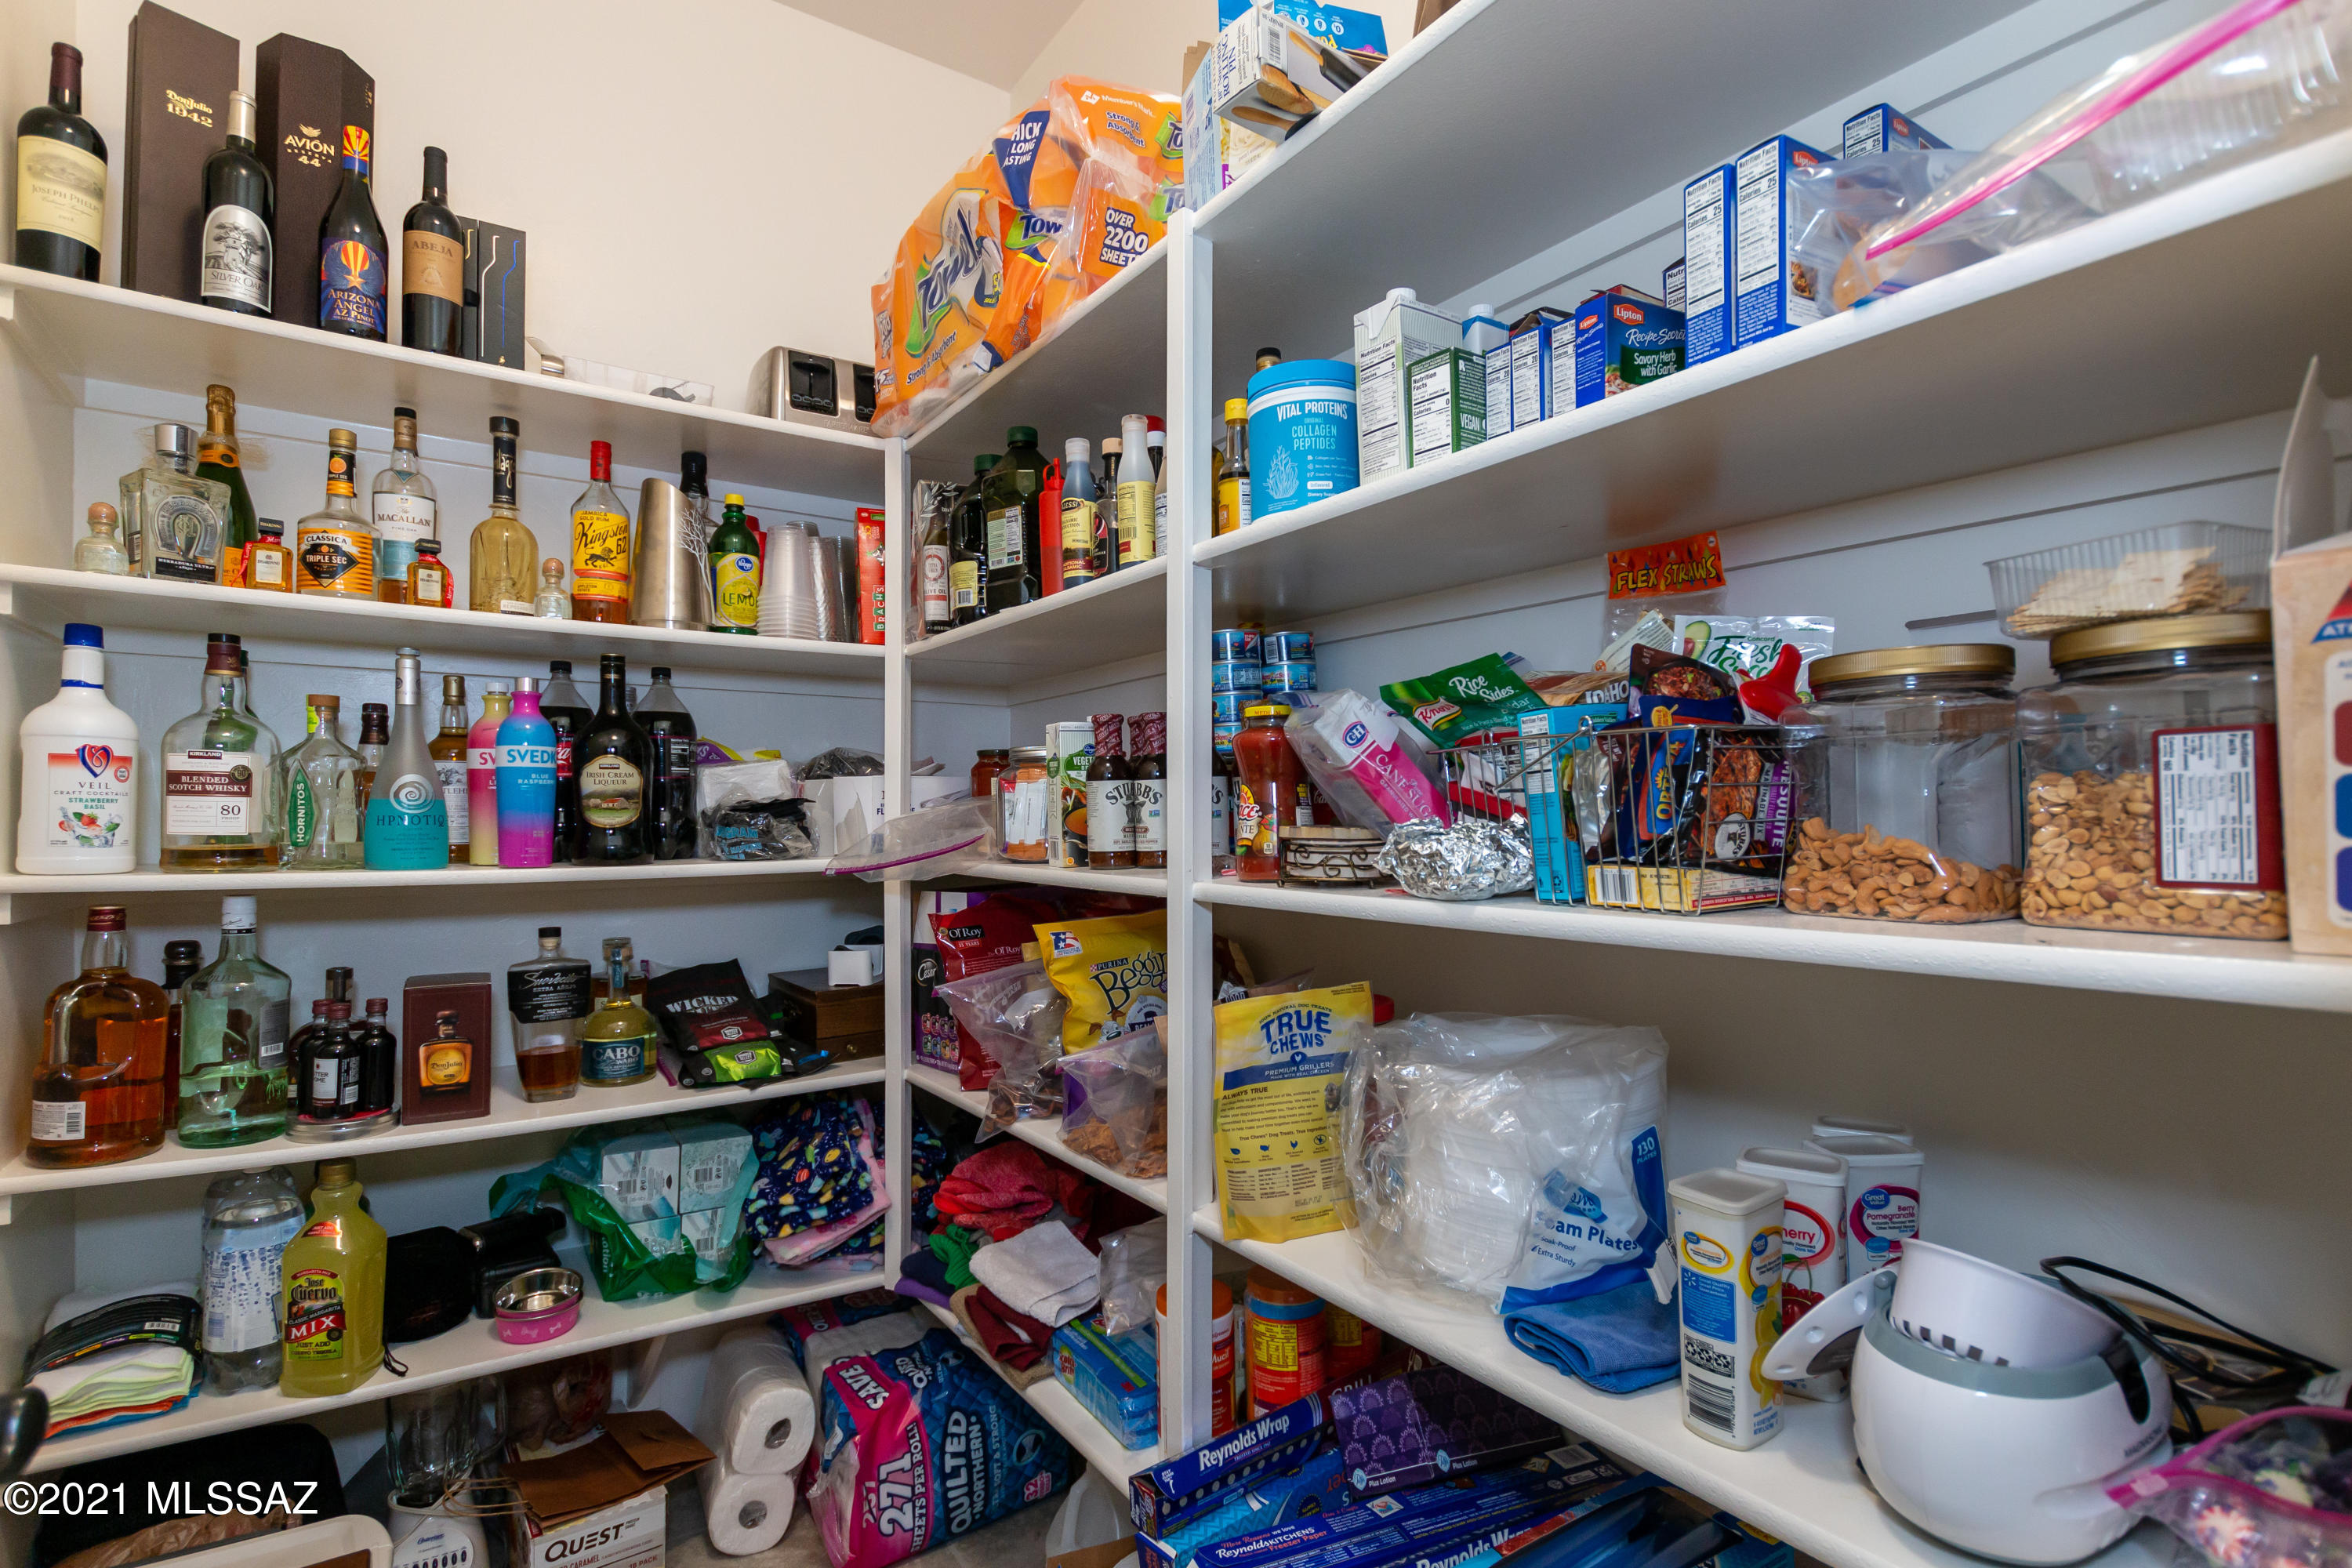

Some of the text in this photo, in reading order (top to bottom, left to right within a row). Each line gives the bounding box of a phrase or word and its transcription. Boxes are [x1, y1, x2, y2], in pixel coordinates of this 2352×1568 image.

[1102, 93, 1138, 110] Member's
[165, 103, 213, 127] 1942
[1106, 111, 1134, 129] Strong
[1846, 111, 1882, 132] Nutrition Facts
[1011, 122, 1041, 142] HICK
[1106, 120, 1146, 148] Absorbent
[1011, 140, 1035, 154] LONG
[1872, 136, 1882, 148] 25
[299, 155, 321, 167] 44
[1003, 153, 1032, 168] ASTING
[1738, 143, 1777, 170] Nutrition Facts
[31, 183, 67, 199] JOSEPH
[1686, 173, 1722, 197] Nutrition Facts
[1738, 176, 1777, 203] Calories 25
[1105, 206, 1134, 228] OVER
[1686, 204, 1722, 230] Calories 25
[1105, 225, 1149, 253] 2200
[412, 241, 454, 259] ABEJA
[1101, 247, 1140, 267] SHEET
[211, 270, 242, 285] SILVER
[327, 289, 381, 311] ARIZONA
[333, 298, 376, 318] ANGEL
[334, 308, 376, 325] AZ PINOT
[1579, 315, 1599, 328] Lipton
[1617, 307, 1643, 321] Lipton
[1552, 324, 1567, 335] Nutrition
[1625, 328, 1659, 347] Recipe
[1360, 338, 1396, 358] Nutrition Facts
[1512, 332, 1538, 346] Nutrition Facts
[1501, 347, 1510, 356] Facts
[1553, 350, 1568, 360] Calories
[1634, 350, 1676, 366] Savory Herb
[1513, 355, 1538, 370] Calories 20
[1641, 363, 1677, 377] with Garlic
[906, 365, 927, 385] Strong
[1360, 372, 1377, 383] Calories
[1413, 371, 1437, 384] Nutrition
[1486, 376, 1501, 385] Calories
[1413, 381, 1428, 392] Facts
[1276, 401, 1348, 423] VITAL PROTEINS
[1413, 405, 1432, 417] Calories
[1291, 424, 1338, 437] COLLAGEN
[1460, 412, 1480, 431] VEGAN
[1294, 437, 1336, 451] PEPTIDES
[377, 514, 432, 528] MACALLAN
[306, 534, 347, 546] CLASSICA
[575, 521, 628, 554] Kingston
[616, 536, 628, 555] 62
[306, 554, 347, 565] TRIPLE SEC
[738, 557, 753, 570] Kroger
[1616, 554, 1719, 592] FLEX STRAWS
[1448, 674, 1515, 703] Rice Sides
[181, 775, 229, 784] BLENDED
[1375, 753, 1409, 792] CANE
[205, 784, 248, 793] WHISKY
[220, 804, 241, 816] 80
[296, 782, 306, 842] HORNITOS
[376, 814, 445, 828] HPNOTIQ
[917, 966, 937, 982] Cesar
[1098, 959, 1128, 971] PURINA
[666, 994, 739, 1014] WICKED
[1310, 1004, 1333, 1013] TREATS
[1261, 1009, 1333, 1045] TRUE
[592, 1044, 641, 1061] CABO
[1269, 1033, 1327, 1055] CHEWS
[1265, 1061, 1335, 1077] PREMIUM GRILLERS
[1222, 1086, 1269, 1102] ALWAYS TRUE
[1637, 1137, 1655, 1156] 130
[1867, 1212, 1915, 1221] Pomegranate
[1588, 1225, 1639, 1251] Plates
[1537, 1247, 1576, 1267] Extra Sturdy
[304, 1277, 324, 1288] Jose
[291, 1284, 337, 1304] Cuervo
[289, 1305, 341, 1325] CLASSIC MARGARITA
[290, 1315, 336, 1340] MIX
[838, 1363, 891, 1410] SAVE
[1198, 1414, 1290, 1472] Reynolds Wrap
[945, 1410, 973, 1534] QUILTED
[968, 1423, 986, 1515] NORTHERN
[913, 1465, 926, 1496] PER
[1025, 1478, 1039, 1501] 32
[1368, 1475, 1396, 1489] Plus Lotion
[877, 1451, 914, 1537] 271
[545, 1523, 625, 1563] QUEST
[1221, 1537, 1241, 1549] More
[1281, 1525, 1295, 1534] love
[1269, 1529, 1328, 1553] Freezer Paper
